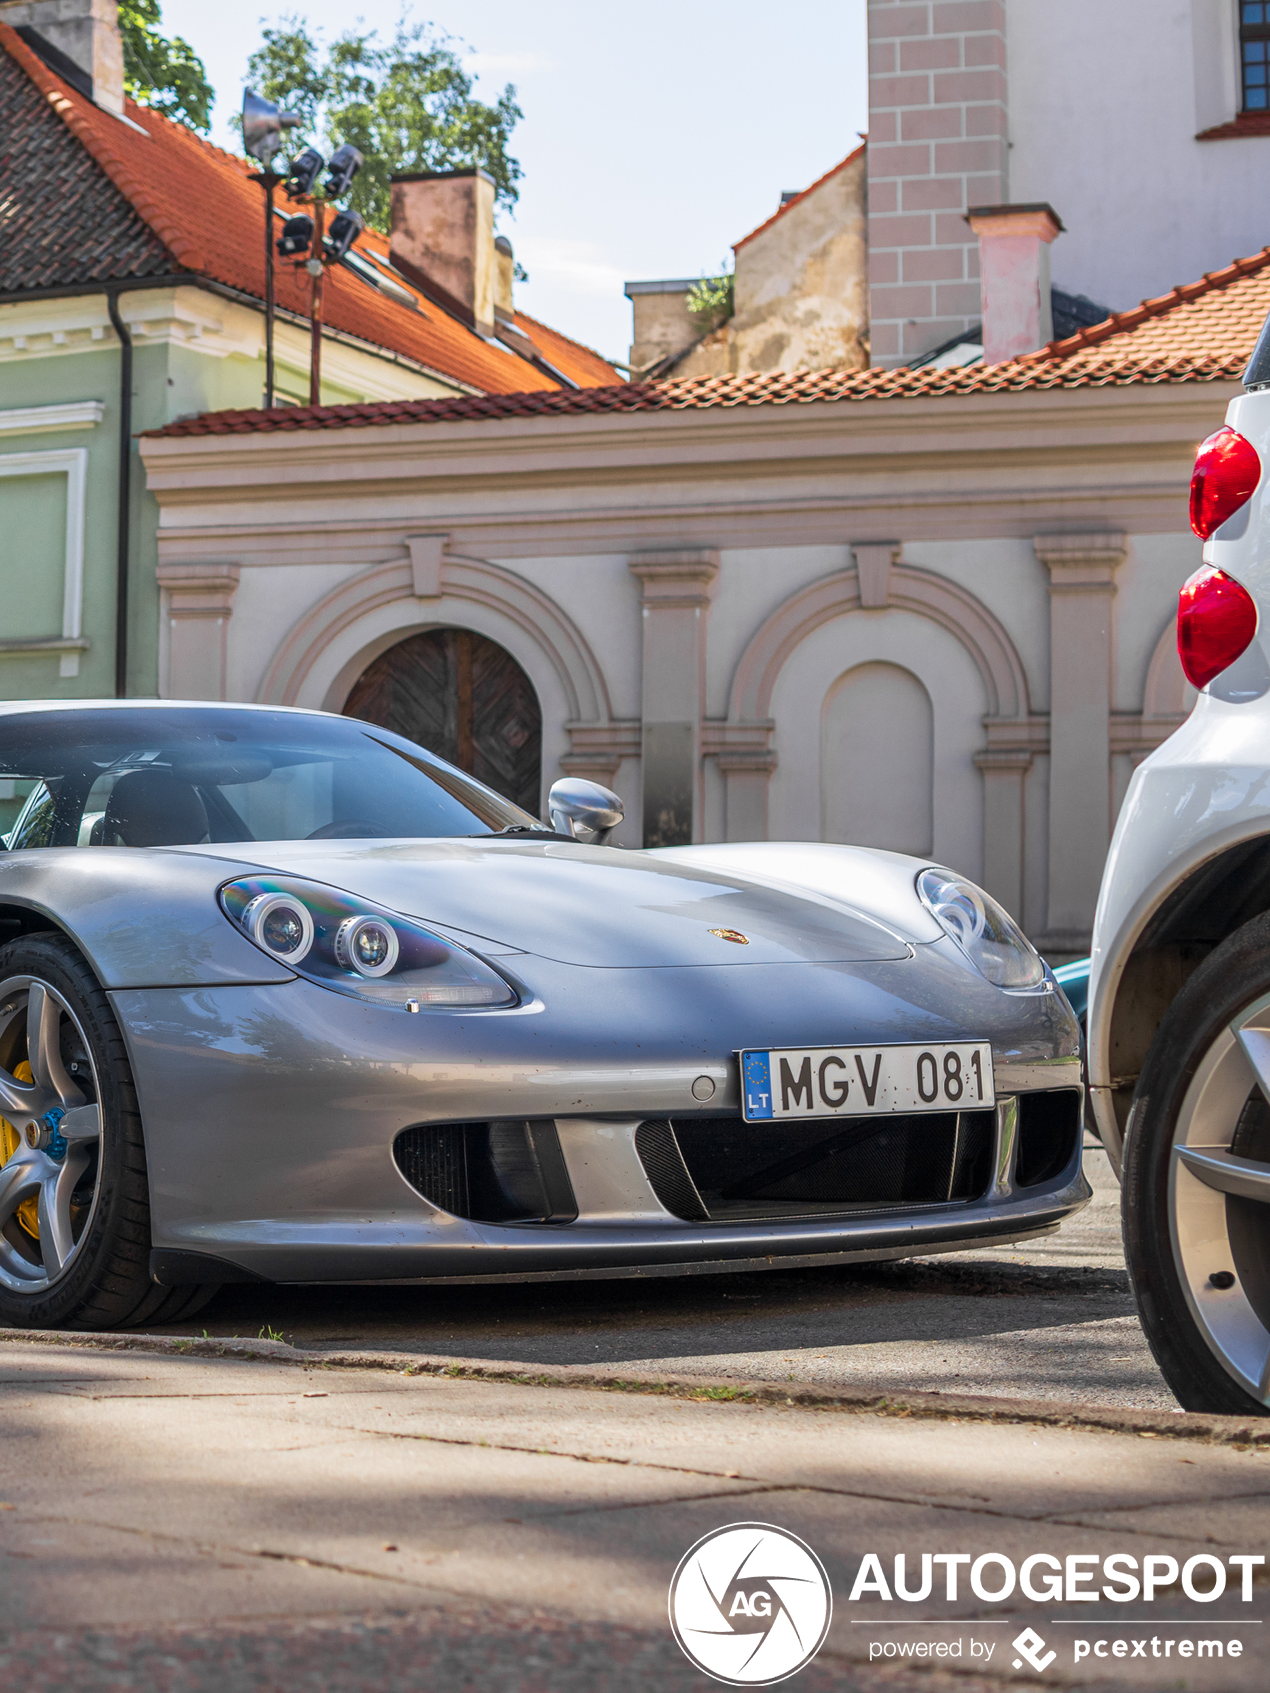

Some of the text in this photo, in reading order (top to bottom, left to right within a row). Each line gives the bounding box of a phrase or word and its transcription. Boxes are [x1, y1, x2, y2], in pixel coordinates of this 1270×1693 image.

[779, 1050, 984, 1110] MGV 081
[748, 1093, 769, 1109] LT
